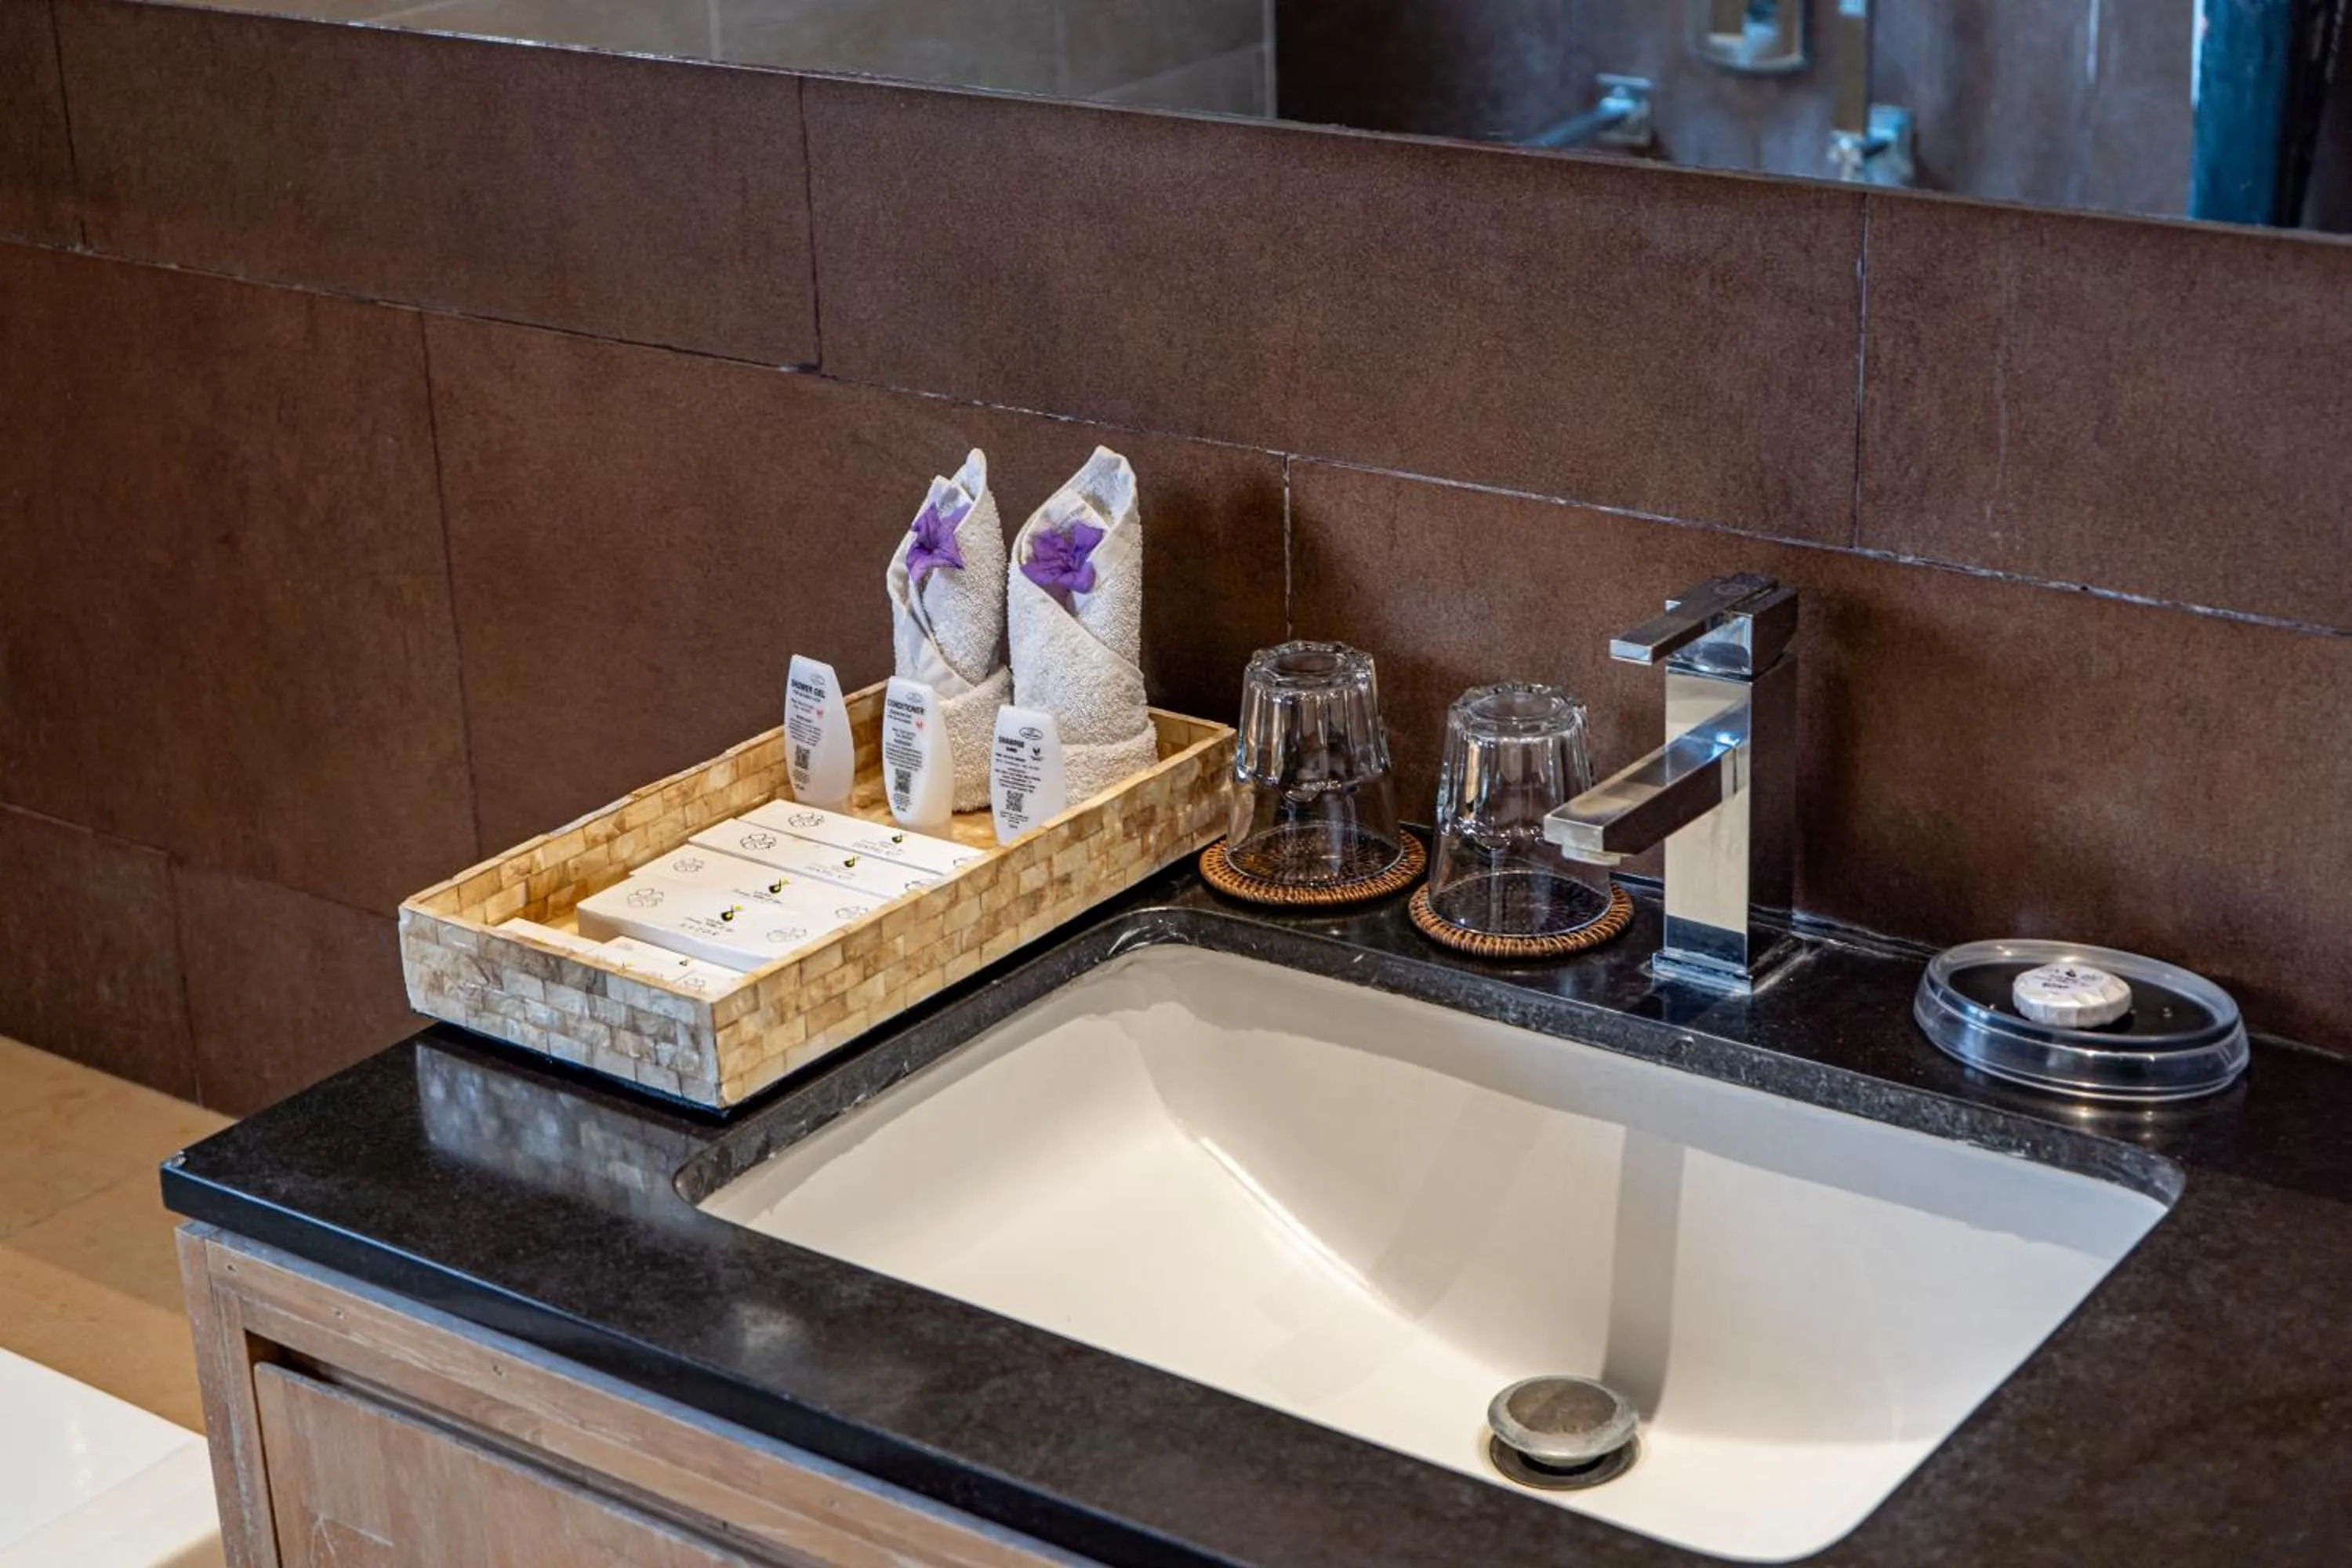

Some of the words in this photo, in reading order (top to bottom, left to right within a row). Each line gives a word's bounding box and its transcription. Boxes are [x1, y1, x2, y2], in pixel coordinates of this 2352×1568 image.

[791, 679, 813, 693] SHOWER
[814, 688, 825, 699] GEL
[887, 699, 924, 714] CONDITIONER
